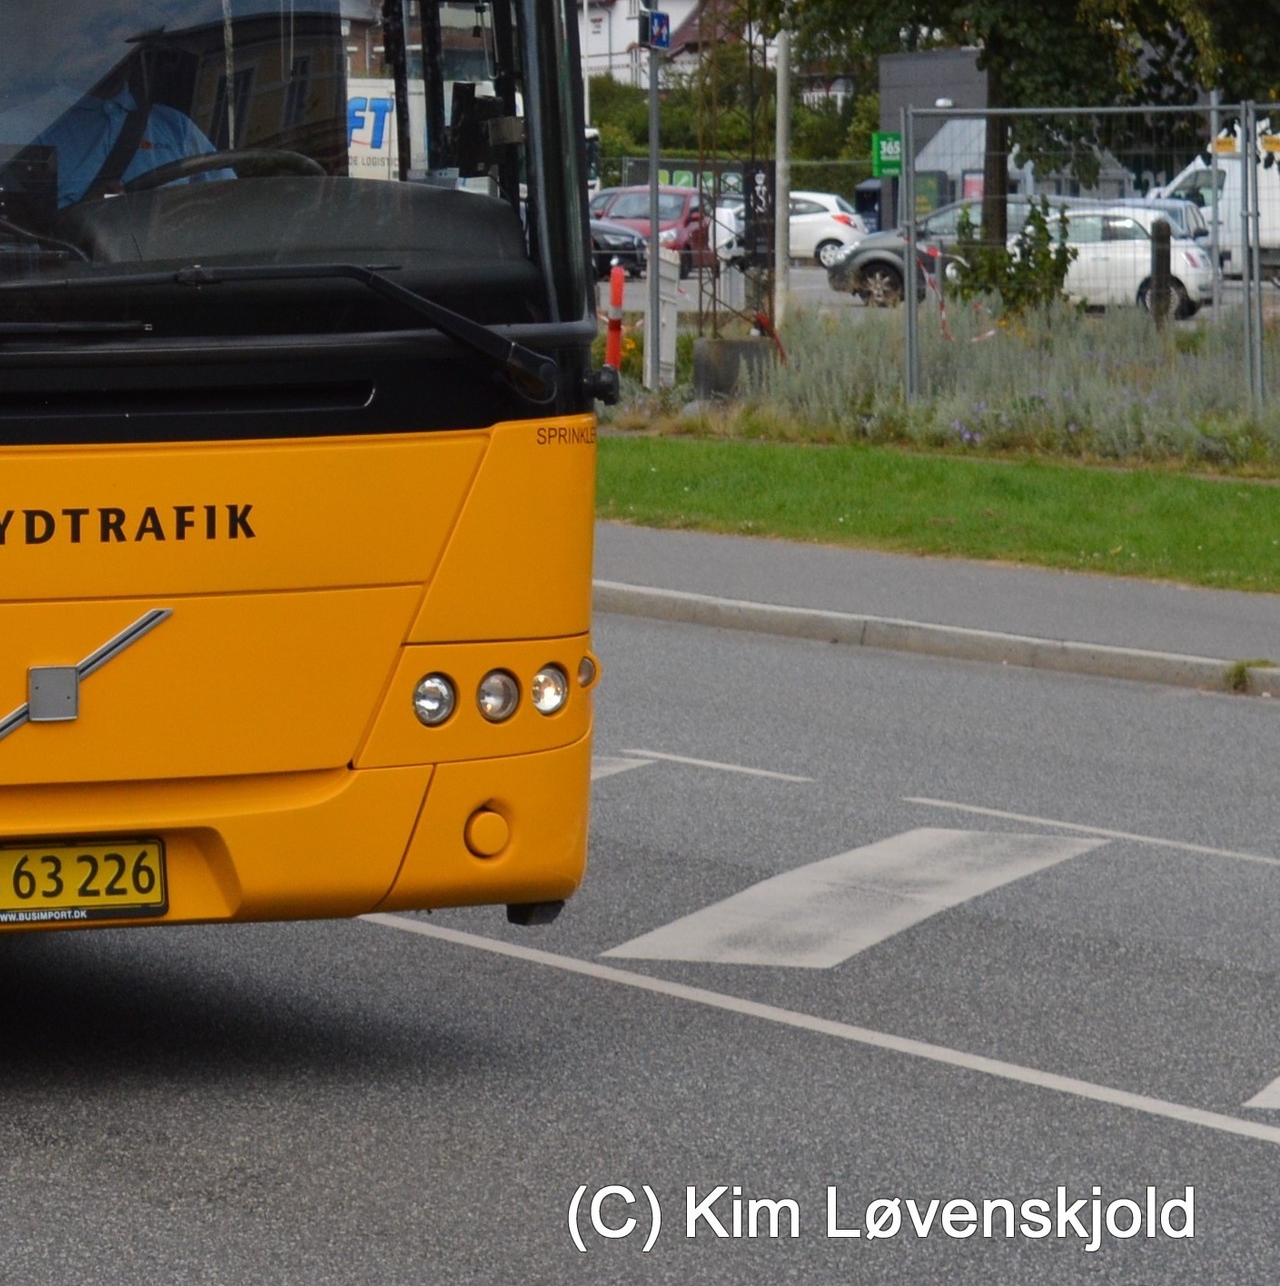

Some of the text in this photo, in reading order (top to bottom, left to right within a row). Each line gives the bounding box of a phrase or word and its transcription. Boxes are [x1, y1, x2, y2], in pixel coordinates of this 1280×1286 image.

[879, 140, 901, 155] 365
[12, 854, 64, 900] 63
[76, 850, 156, 898] 226
